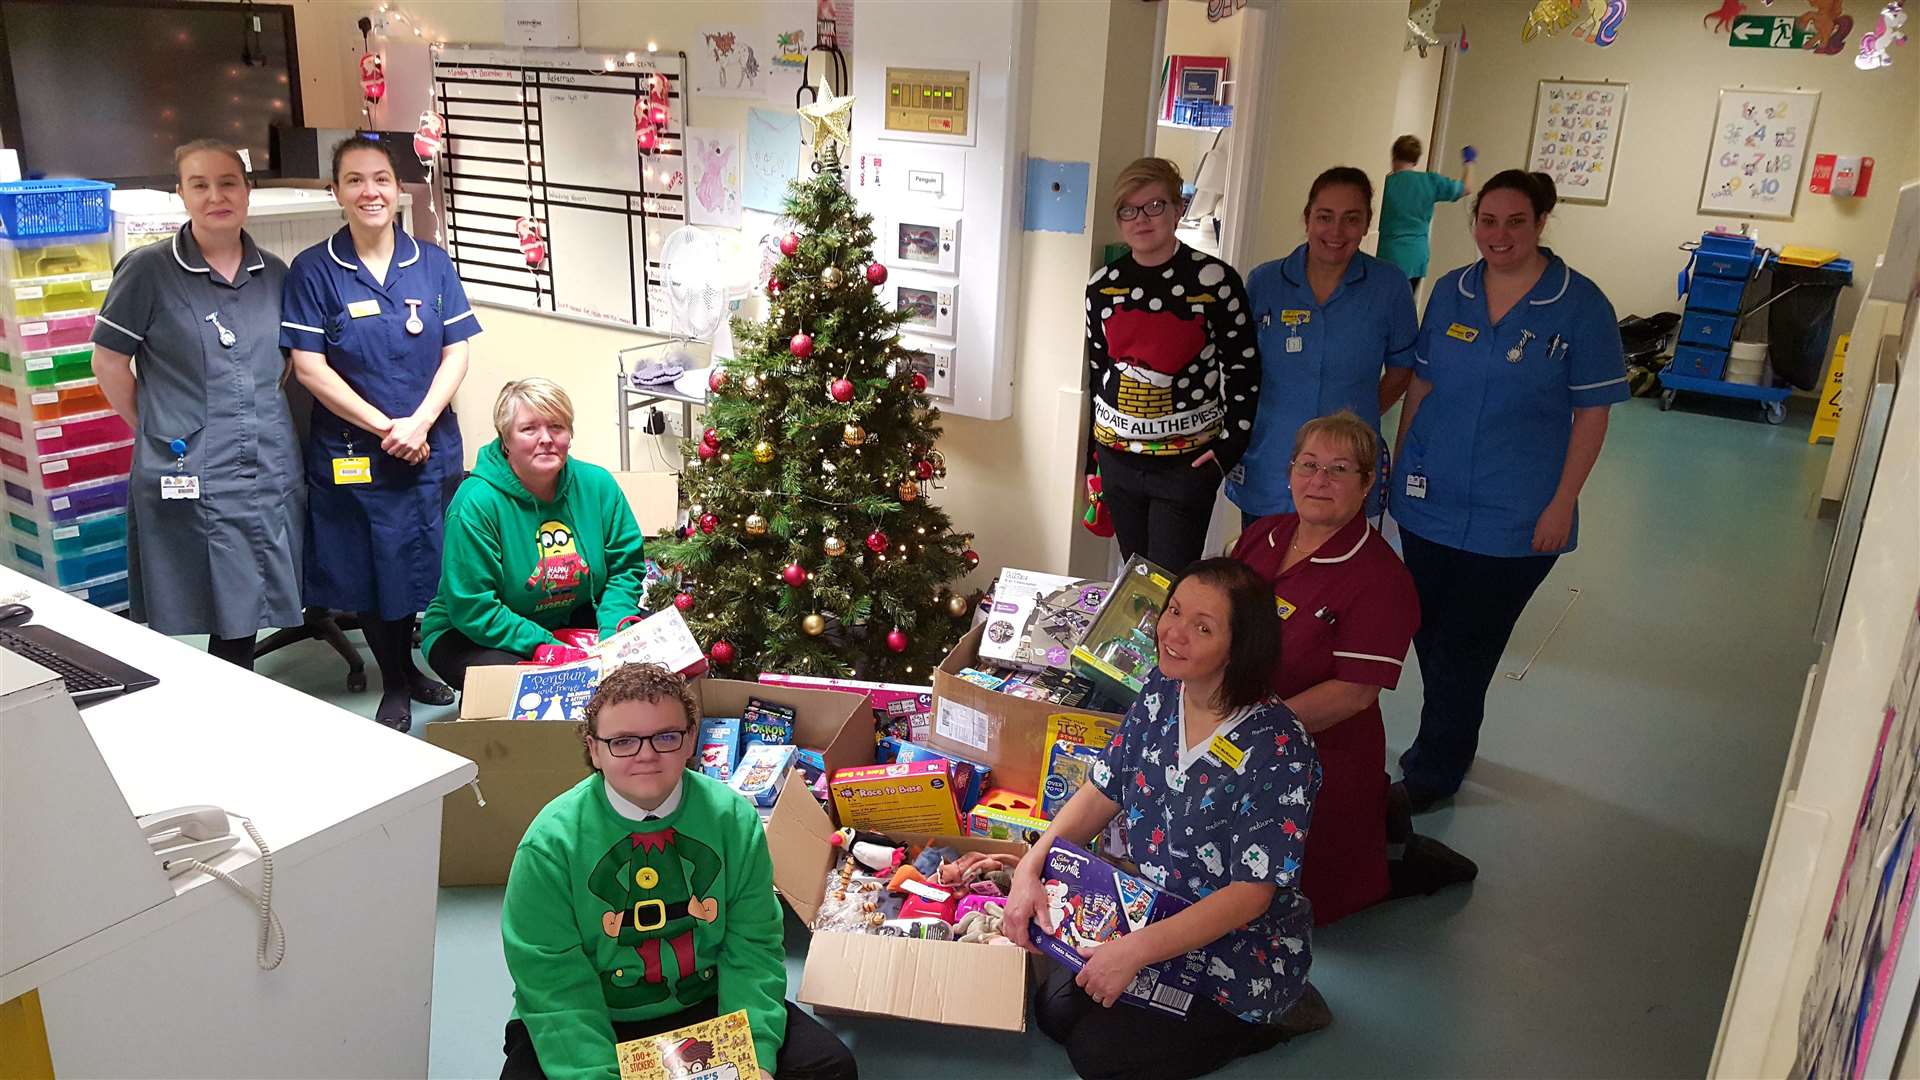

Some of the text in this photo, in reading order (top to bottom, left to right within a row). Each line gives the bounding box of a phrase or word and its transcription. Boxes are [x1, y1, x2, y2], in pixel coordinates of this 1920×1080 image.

[1754, 125, 1767, 141] 4
[915, 176, 937, 184] Penguin
[1760, 178, 1780, 195] 10
[1110, 415, 1129, 431] ATE
[1131, 422, 1158, 435] ALL
[1157, 418, 1190, 434] THE
[548, 566, 569, 574] HAPPY
[531, 670, 587, 690] Penguin
[919, 694, 932, 704] 6+
[1057, 720, 1088, 738] TOY
[860, 788, 883, 798] Race
[885, 787, 896, 795] to
[898, 784, 923, 793] Base
[1046, 780, 1064, 788] OVER
[1248, 817, 1275, 832] medicine
[1050, 857, 1081, 879] Dairy Milk
[632, 1051, 651, 1063] 100+
[629, 1058, 656, 1073] STICKERS!
